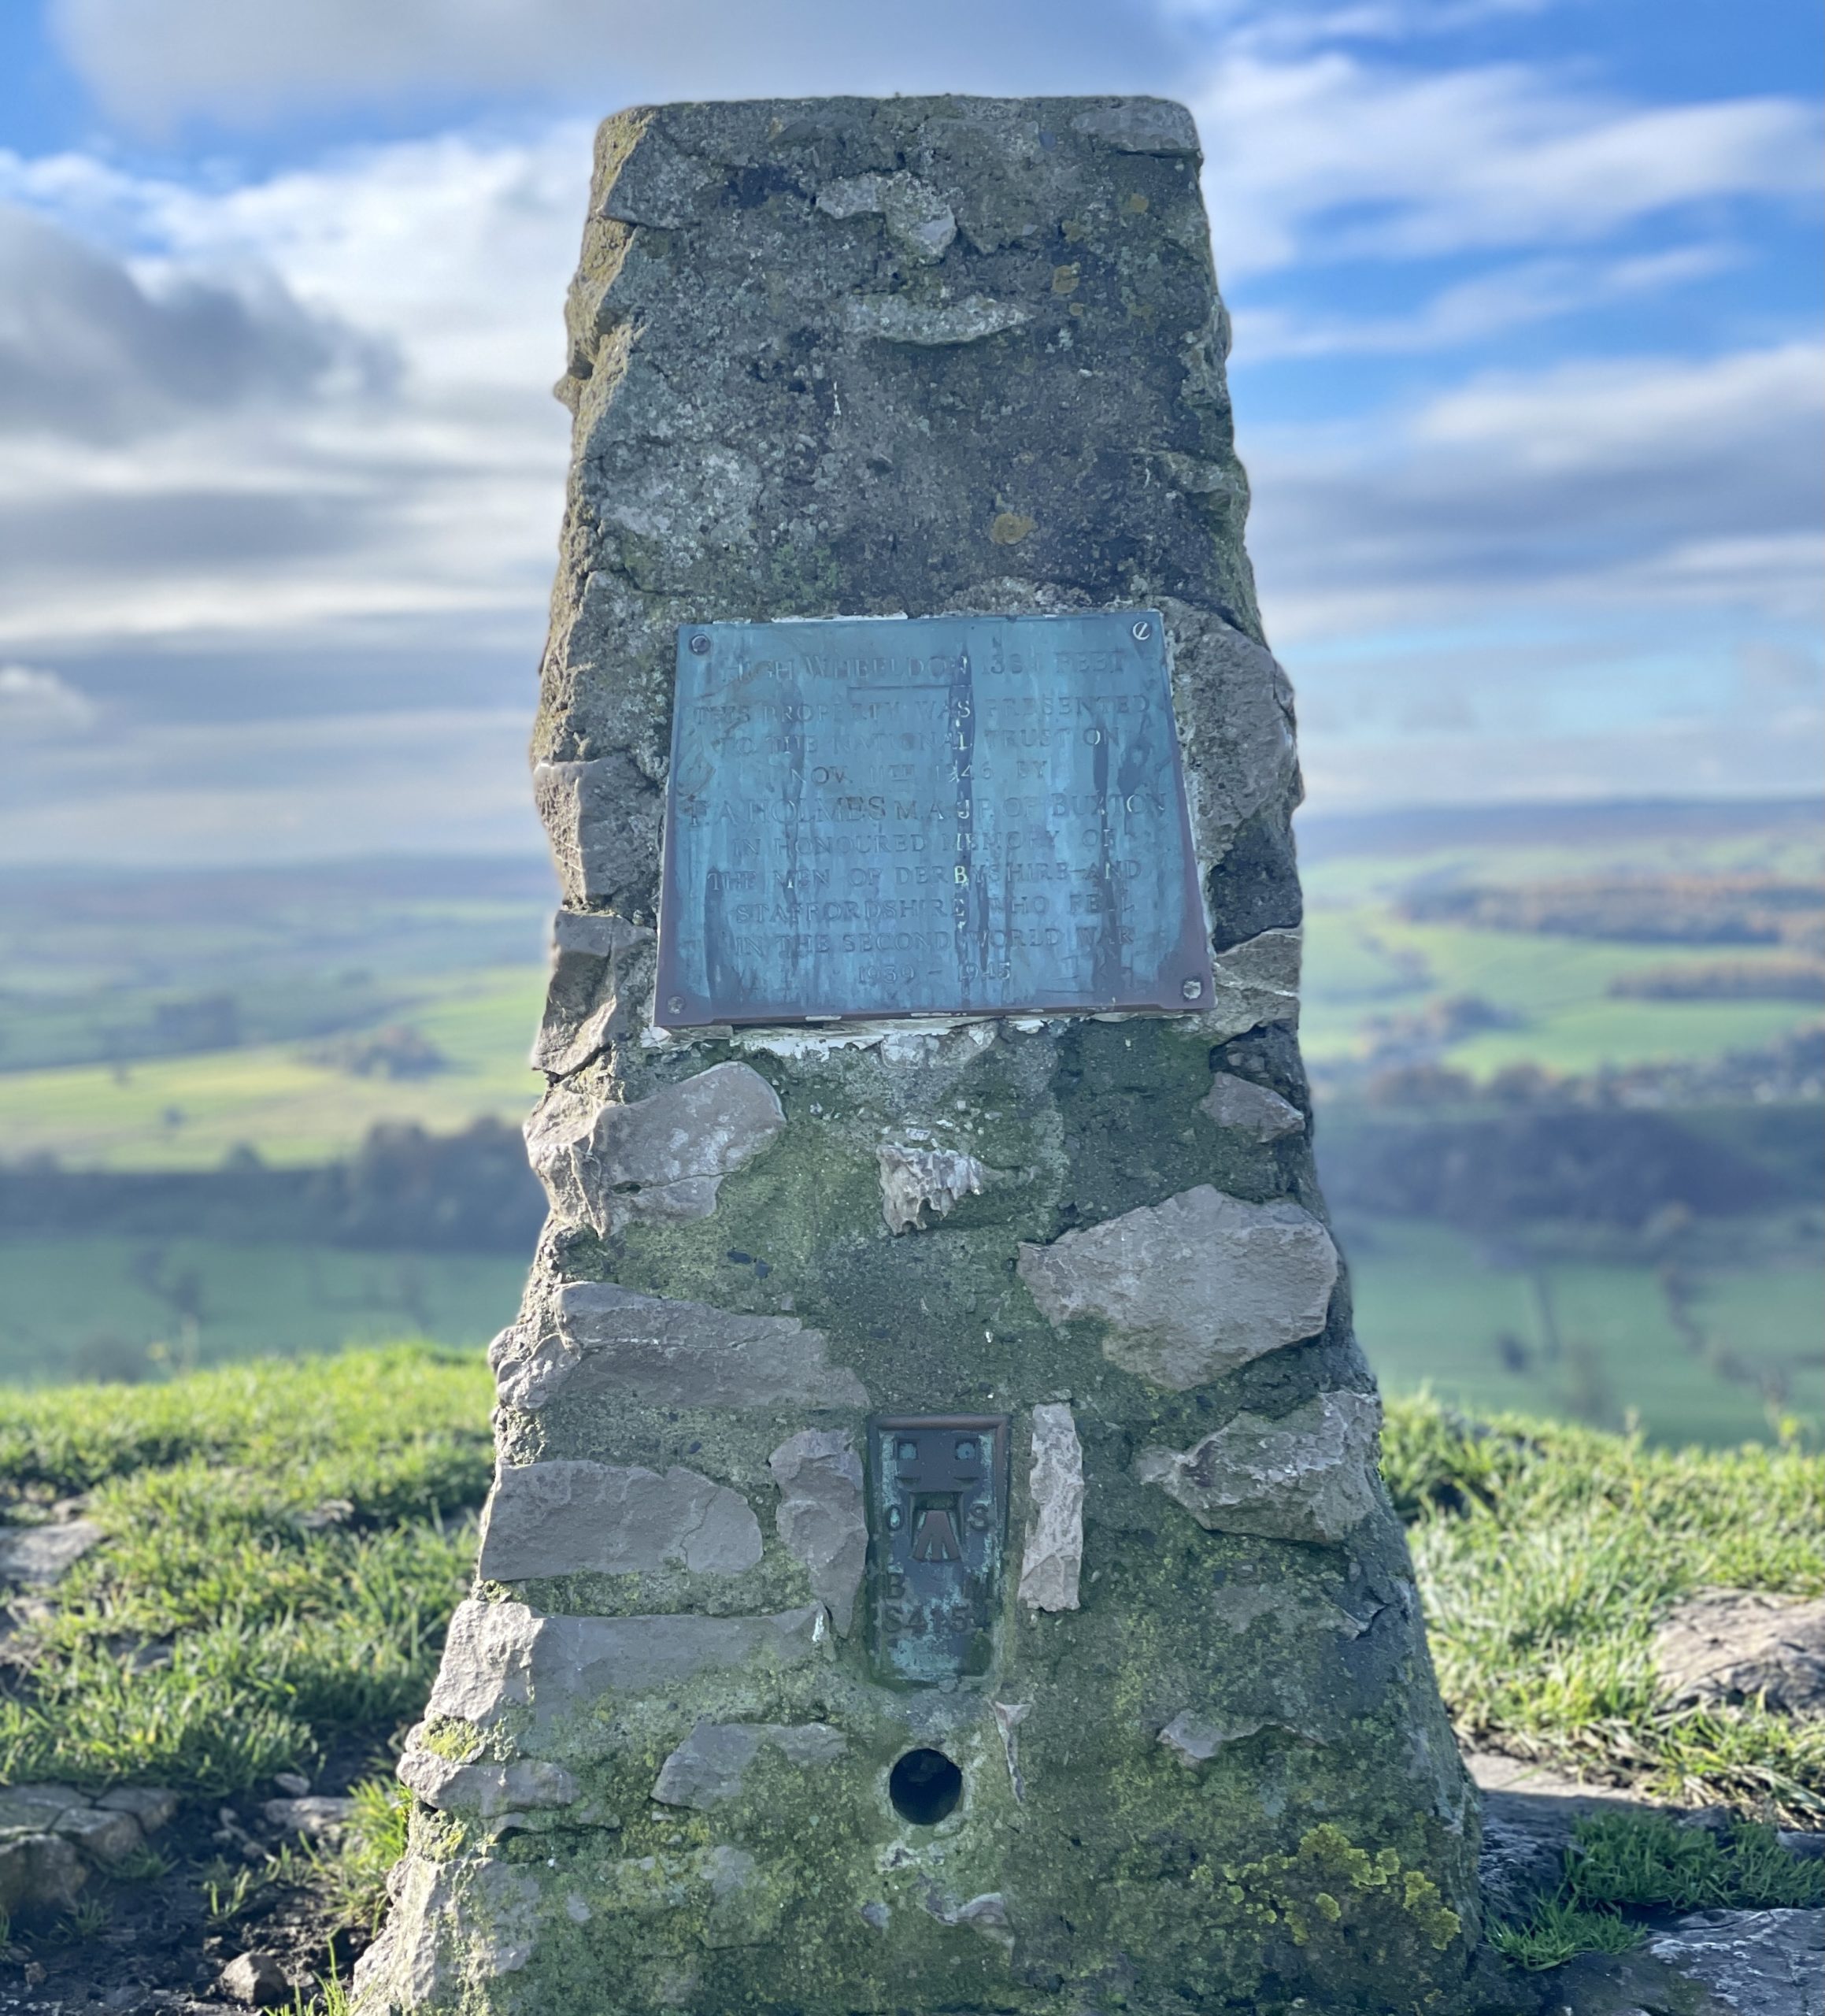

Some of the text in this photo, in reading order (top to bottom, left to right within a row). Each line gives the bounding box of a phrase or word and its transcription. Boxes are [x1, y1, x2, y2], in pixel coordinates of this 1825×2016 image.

[805, 655, 969, 679] WHEELDON
[1055, 650, 1125, 674] FEET
[762, 700, 900, 723] PROPERTY
[914, 699, 971, 720] WAS
[985, 694, 1150, 717] PRESENTED
[716, 727, 1120, 756] TO THE NATIONAL TRUST ON
[1016, 759, 1048, 779] BY
[746, 795, 887, 825] HOLMES
[1002, 795, 1039, 818] OF
[1051, 791, 1166, 817] BUXTON
[733, 827, 1116, 858] IN HONOURED MEMORY OF
[706, 858, 1142, 891] THE MEN OF DERBYSHIRE AND
[735, 898, 965, 925] STAFFORDSHIRE
[987, 895, 1049, 915] WHO
[735, 925, 1135, 958] IN THE SECOND WORLD WAR
[857, 963, 916, 985] 1939
[957, 962, 1012, 983] 1945
[969, 1503, 989, 1532] S
[887, 1572, 905, 1599] B
